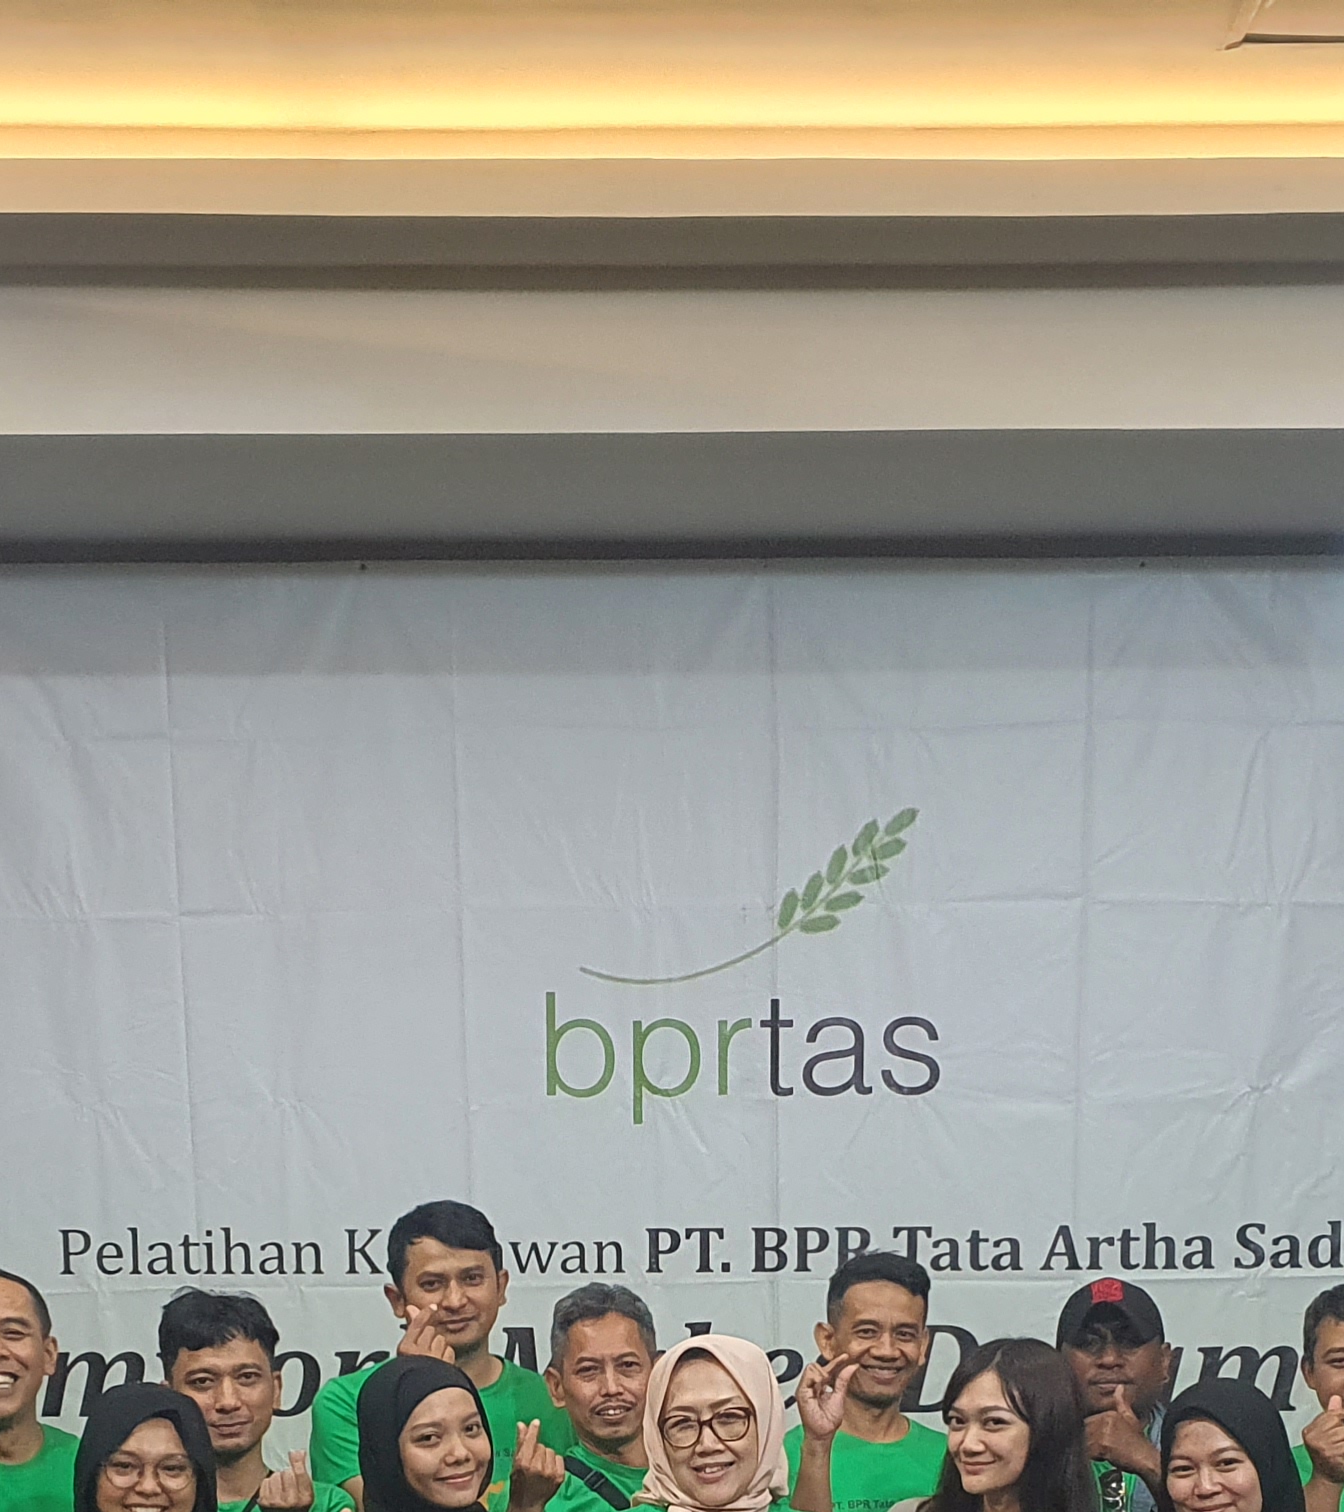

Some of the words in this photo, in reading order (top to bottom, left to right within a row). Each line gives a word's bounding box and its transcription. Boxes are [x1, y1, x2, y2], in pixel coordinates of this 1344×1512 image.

[546, 991, 941, 1125] bprtas
[59, 1228, 323, 1276] Pelatihan
[345, 1228, 624, 1274] Kwan
[646, 1228, 731, 1273] PT.
[893, 1227, 1024, 1272] Tata
[1040, 1223, 1214, 1272] Artha
[848, 1500, 871, 1510] BPR
